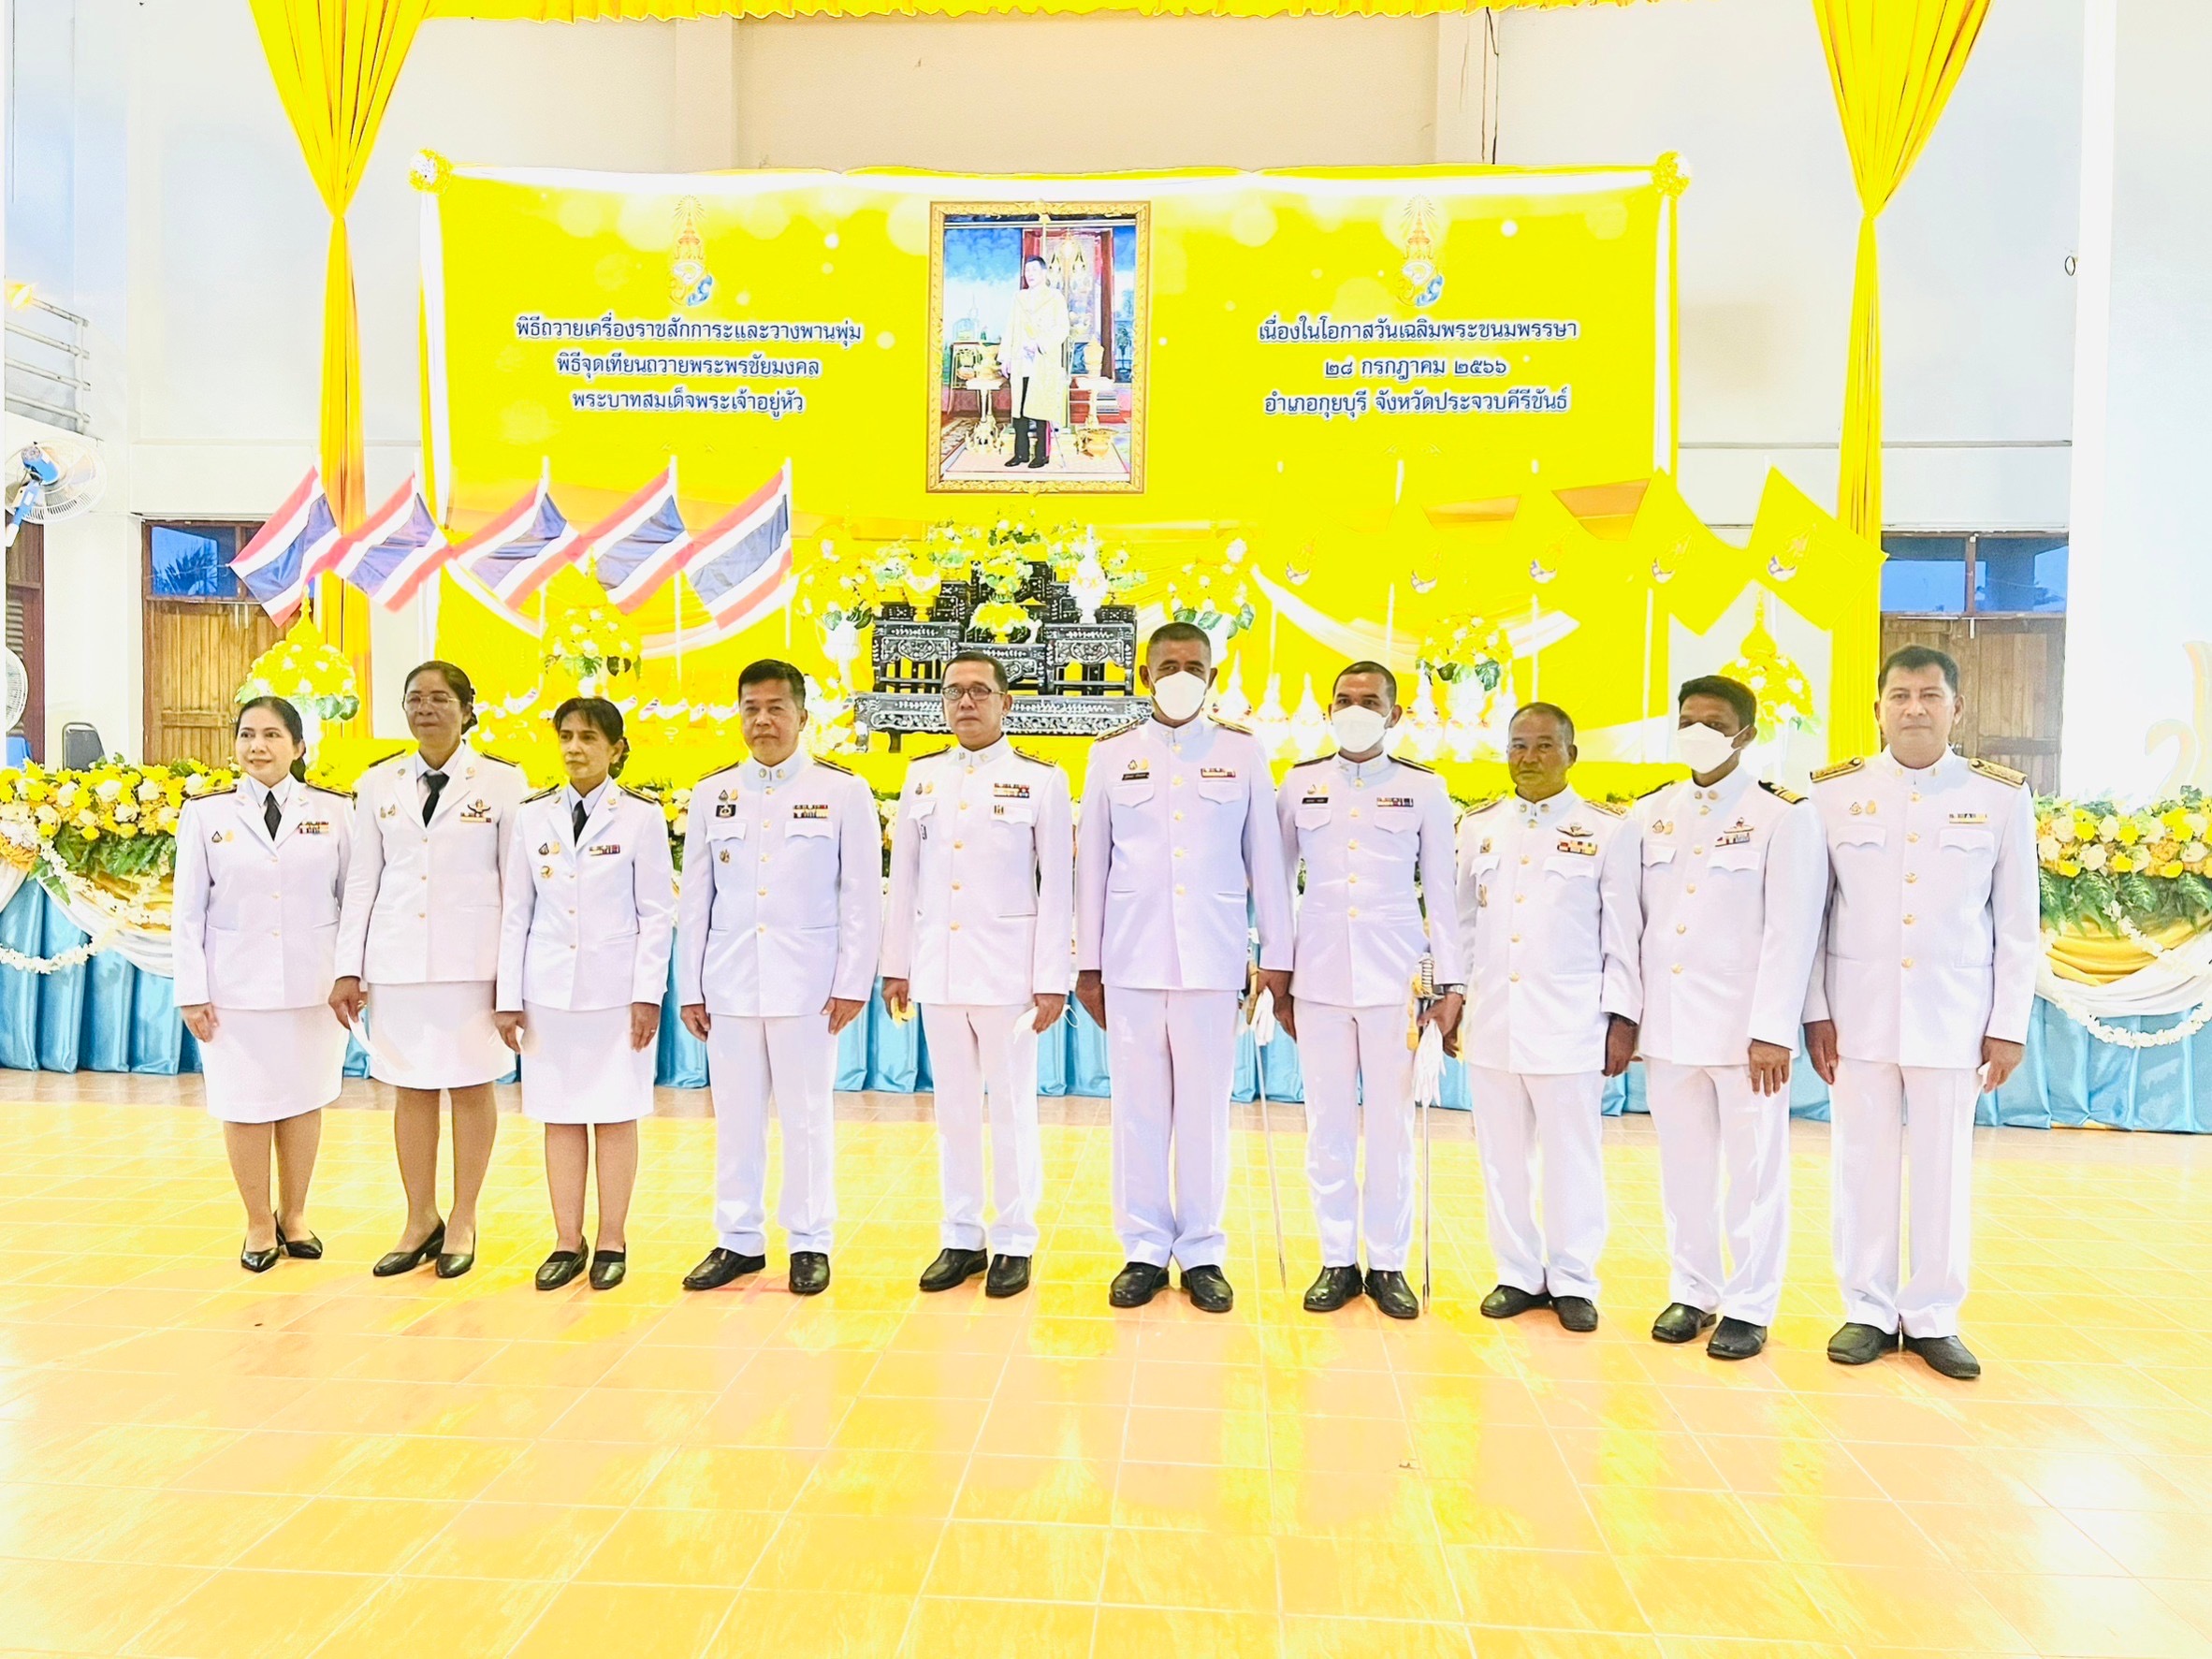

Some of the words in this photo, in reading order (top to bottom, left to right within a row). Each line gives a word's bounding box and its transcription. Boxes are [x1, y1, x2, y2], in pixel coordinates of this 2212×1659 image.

[516, 312, 862, 347] พิธีถวายเครื่องราชสักการะและวางพานพุ่ม
[1259, 314, 1578, 341] เนื่องในโอกาสวันเฉลิมพระชนมพรรษา
[557, 351, 819, 379] พิธีจุดเทียนถวายพระพรชัยมงคล
[1325, 360, 1353, 375] ๒๘
[1361, 359, 1446, 381] กรกฎาคม
[1454, 359, 1507, 375] ๒๕๖๖
[573, 387, 804, 418] พระบาทสมเด็จพระเจ้าอยู่หัว
[1265, 390, 1368, 418] อำเภอกุยบุรี
[1375, 386, 1568, 412] จังหวัดประจวบคีรีขันธ์
